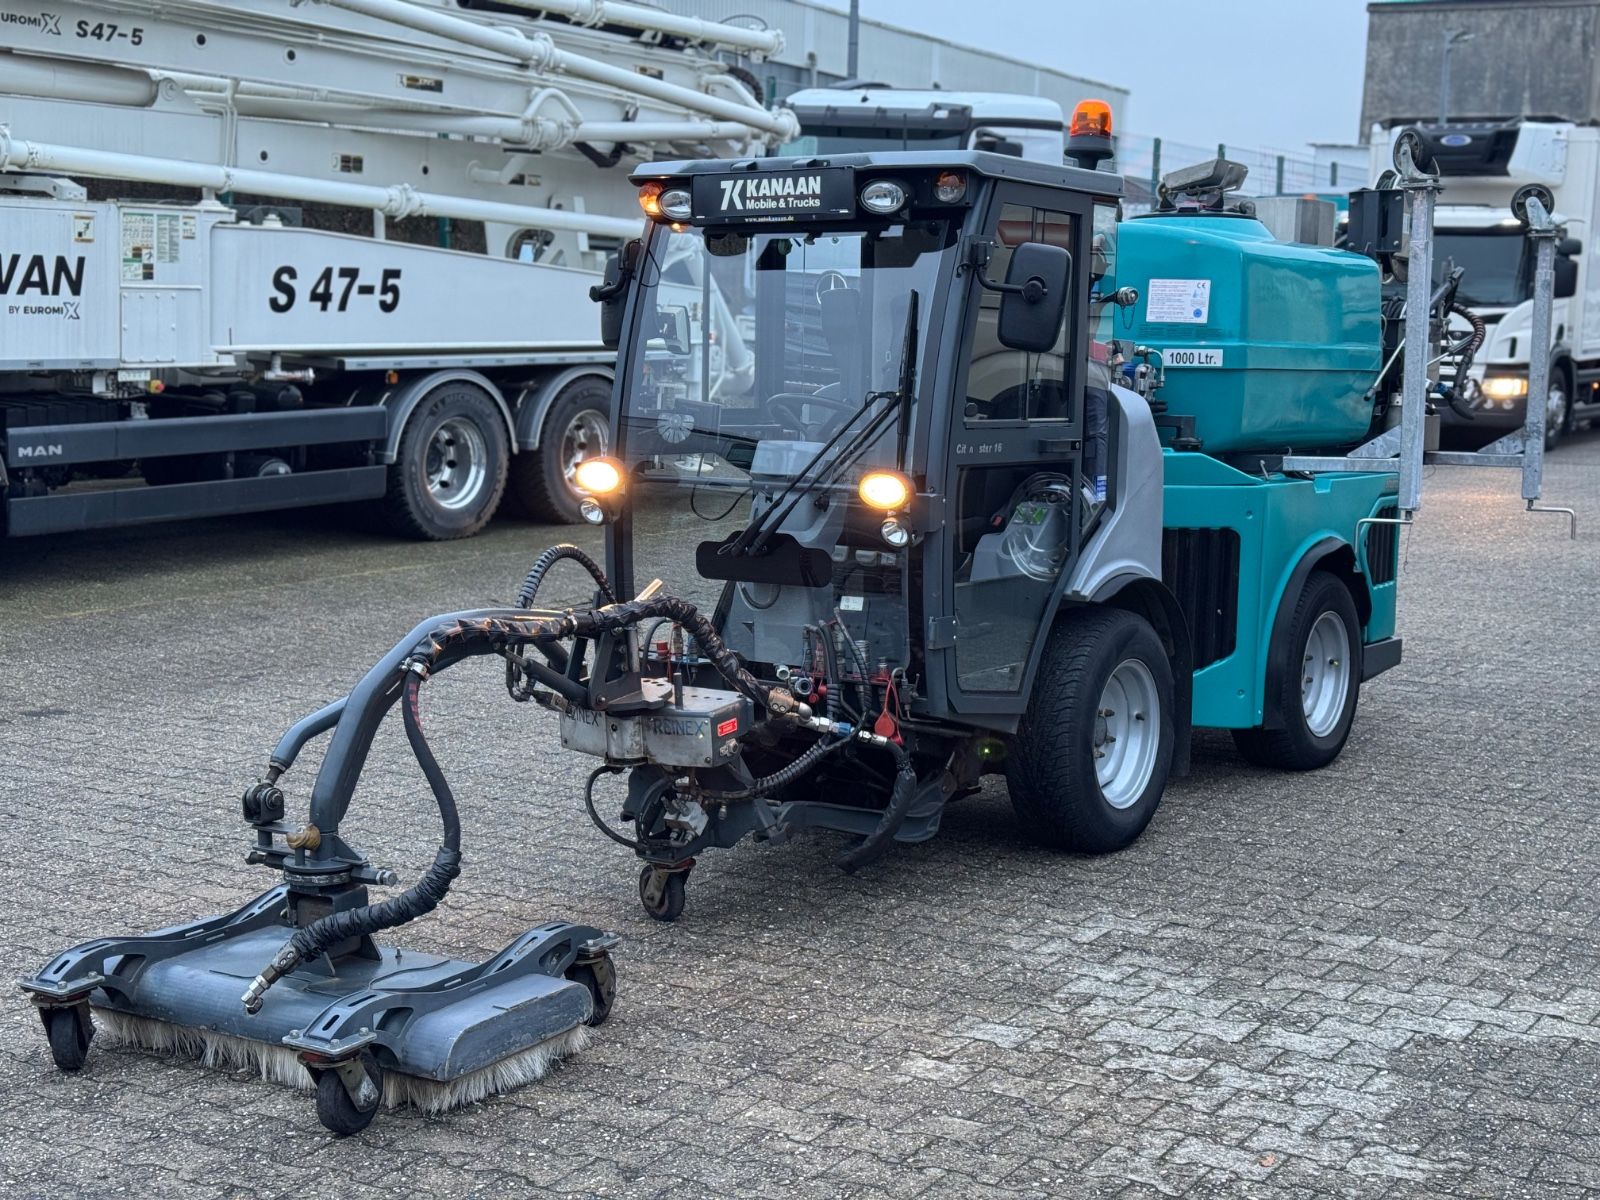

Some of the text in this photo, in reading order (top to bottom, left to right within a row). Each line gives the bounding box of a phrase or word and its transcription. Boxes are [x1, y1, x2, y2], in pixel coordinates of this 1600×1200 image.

[0, 12, 62, 35] UROMIX
[746, 176, 821, 197] KANAAN
[746, 197, 820, 210] Mobile & Trucks
[269, 265, 402, 313] S 47-5
[8, 301, 80, 320] BY EUROMIX
[1169, 352, 1217, 365] 1000 Ltr.
[18, 444, 63, 458] MAN
[994, 442, 1003, 454] 16
